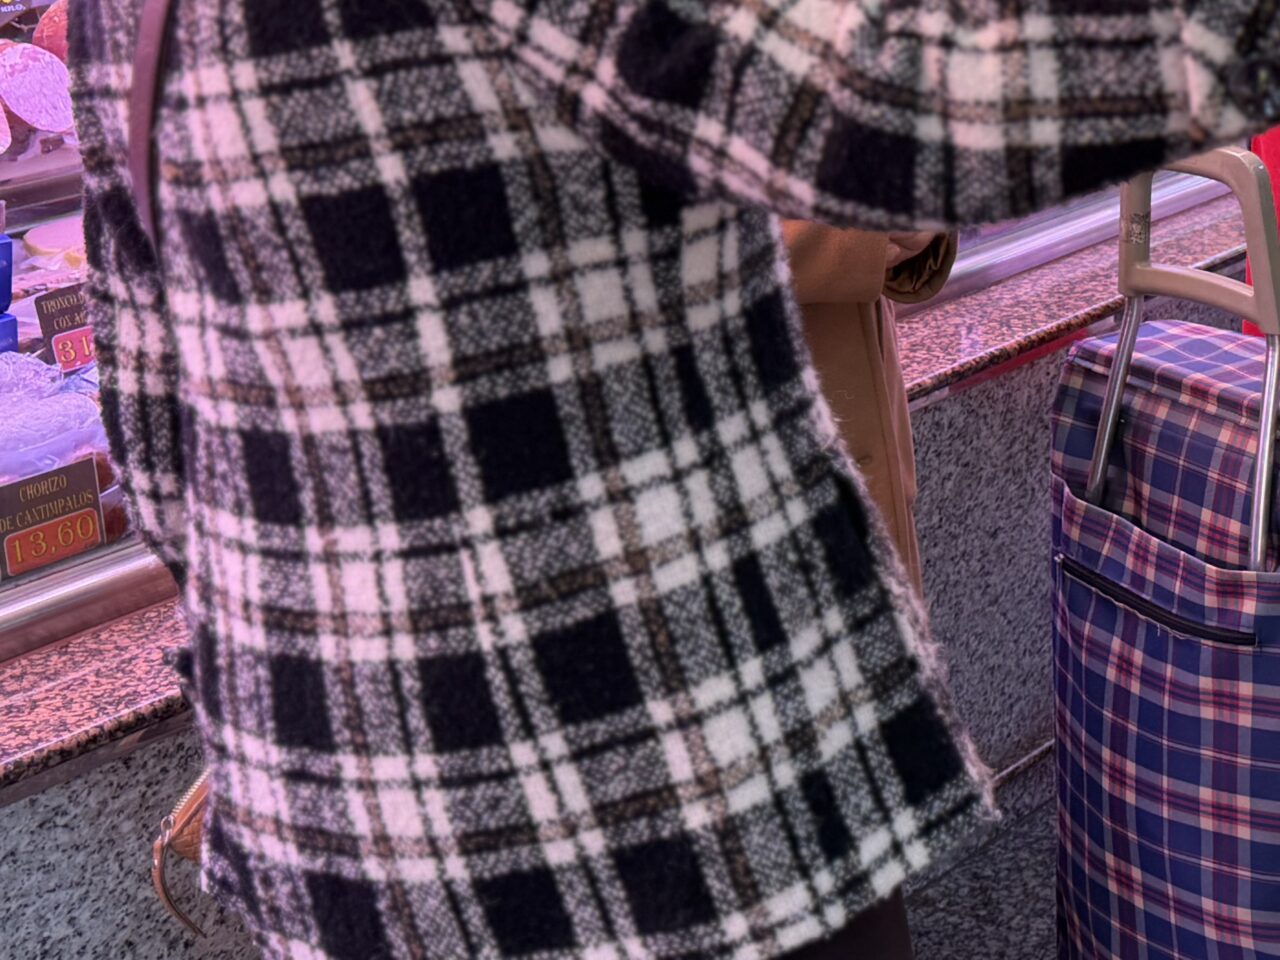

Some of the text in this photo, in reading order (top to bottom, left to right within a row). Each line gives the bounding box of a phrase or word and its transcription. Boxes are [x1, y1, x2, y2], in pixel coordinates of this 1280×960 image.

[20, 475, 67, 502] CHORIZO
[0, 489, 94, 533] DE CANTIMPALOS
[13, 515, 94, 563] 13,60
